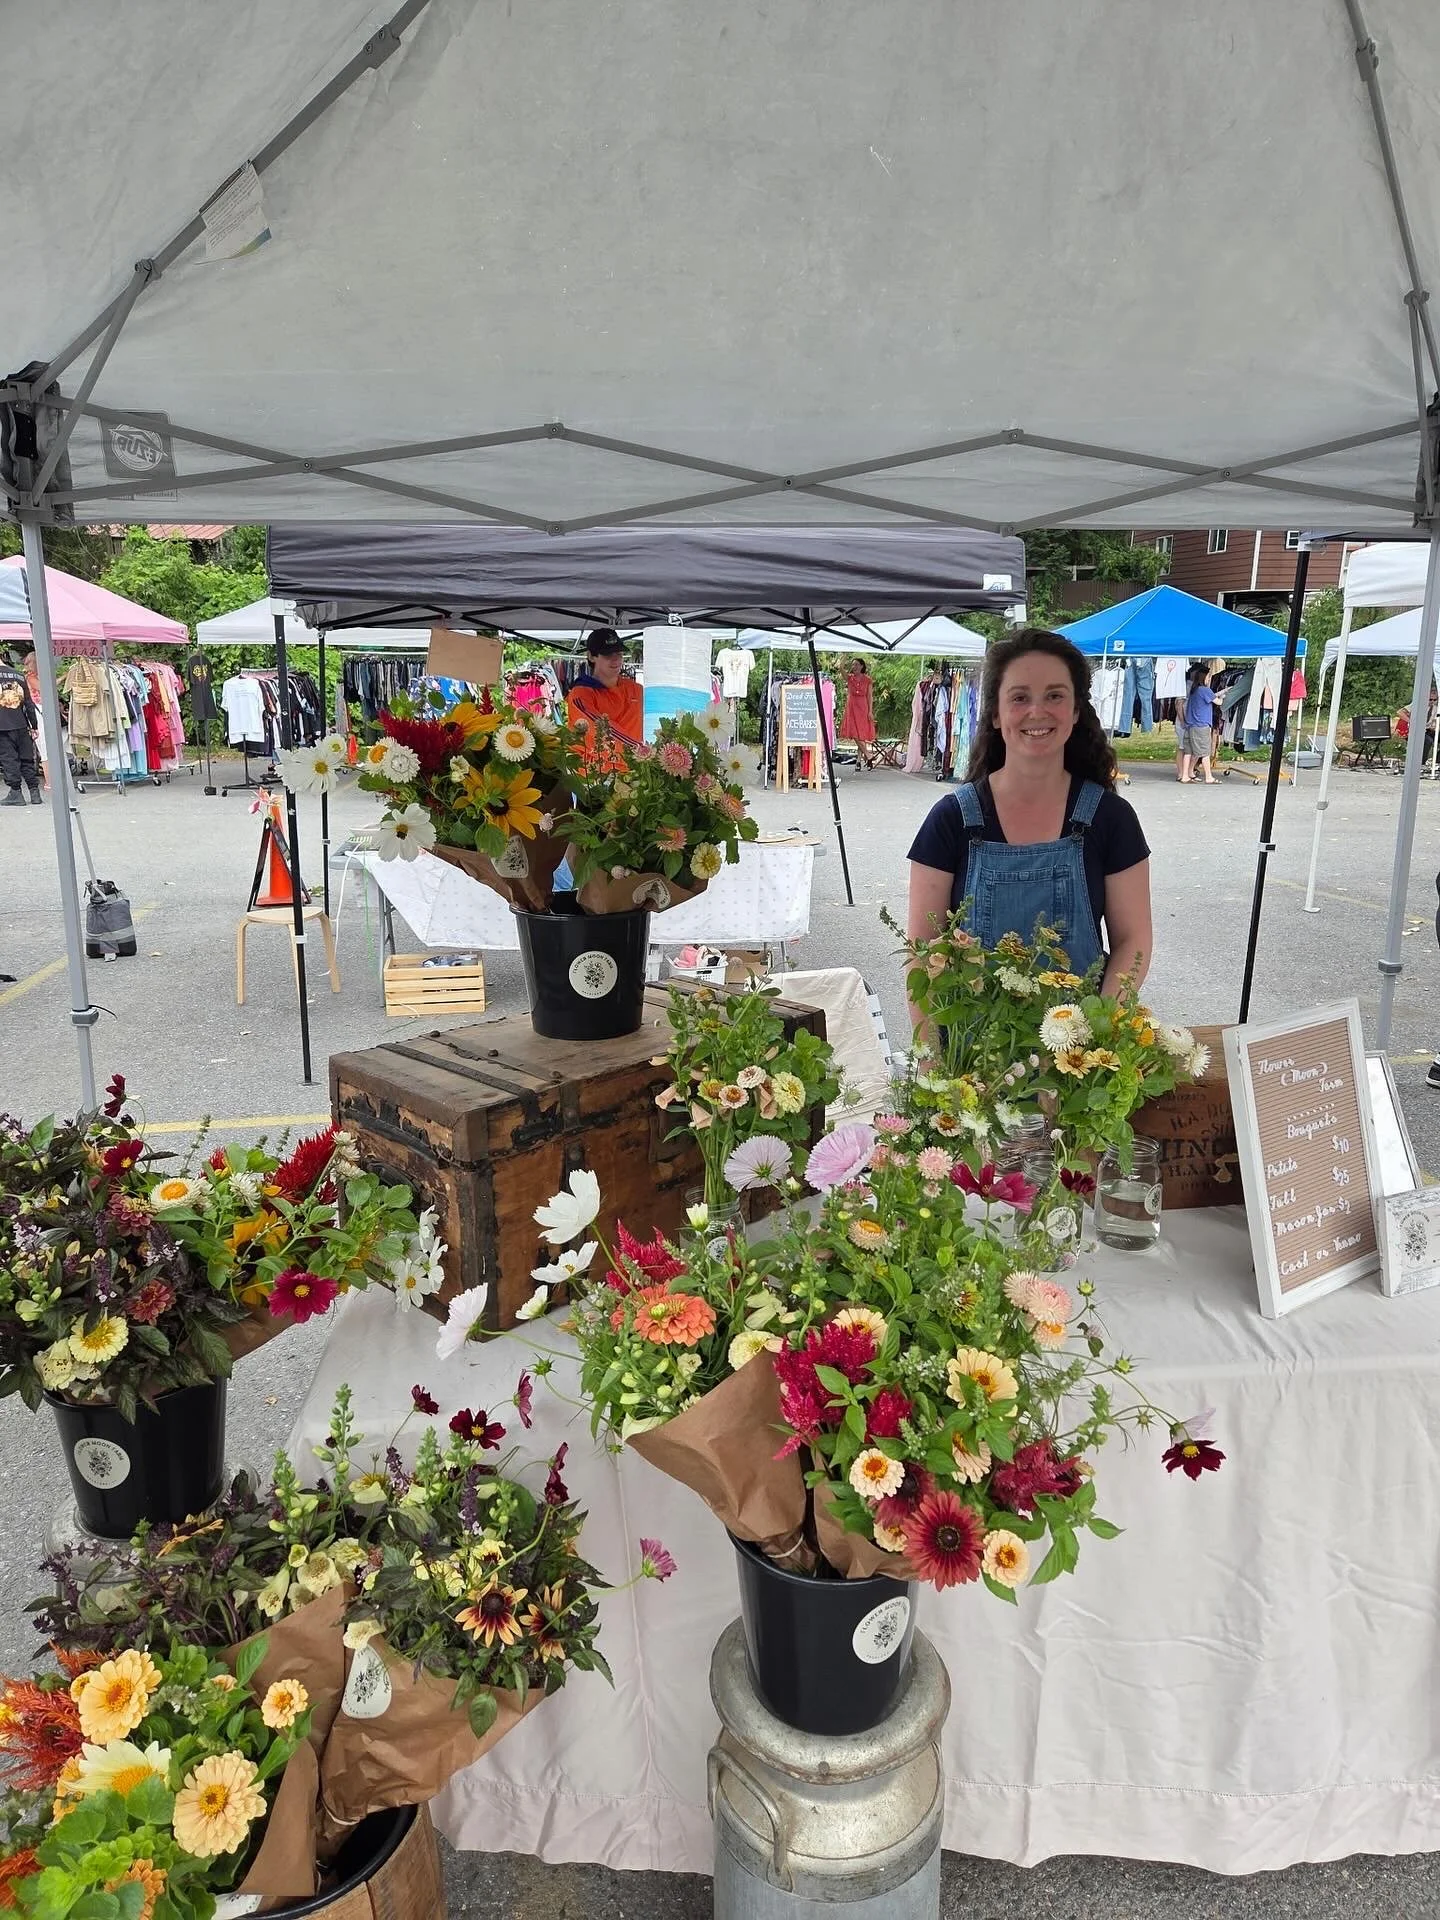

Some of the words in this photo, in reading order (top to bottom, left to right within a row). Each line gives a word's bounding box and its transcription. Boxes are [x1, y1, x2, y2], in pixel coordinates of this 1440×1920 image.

[1258, 1059, 1295, 1075] Flower
[1318, 1077, 1344, 1093] Farm
[1287, 1112, 1338, 1141] Bouquets
[1331, 1135, 1350, 1155] $10
[1269, 1187, 1297, 1211] Tall
[1274, 1214, 1315, 1236] Mason
[1336, 1196, 1352, 1215] $2
[1280, 1249, 1309, 1275] Cash
[1315, 1249, 1329, 1260] or
